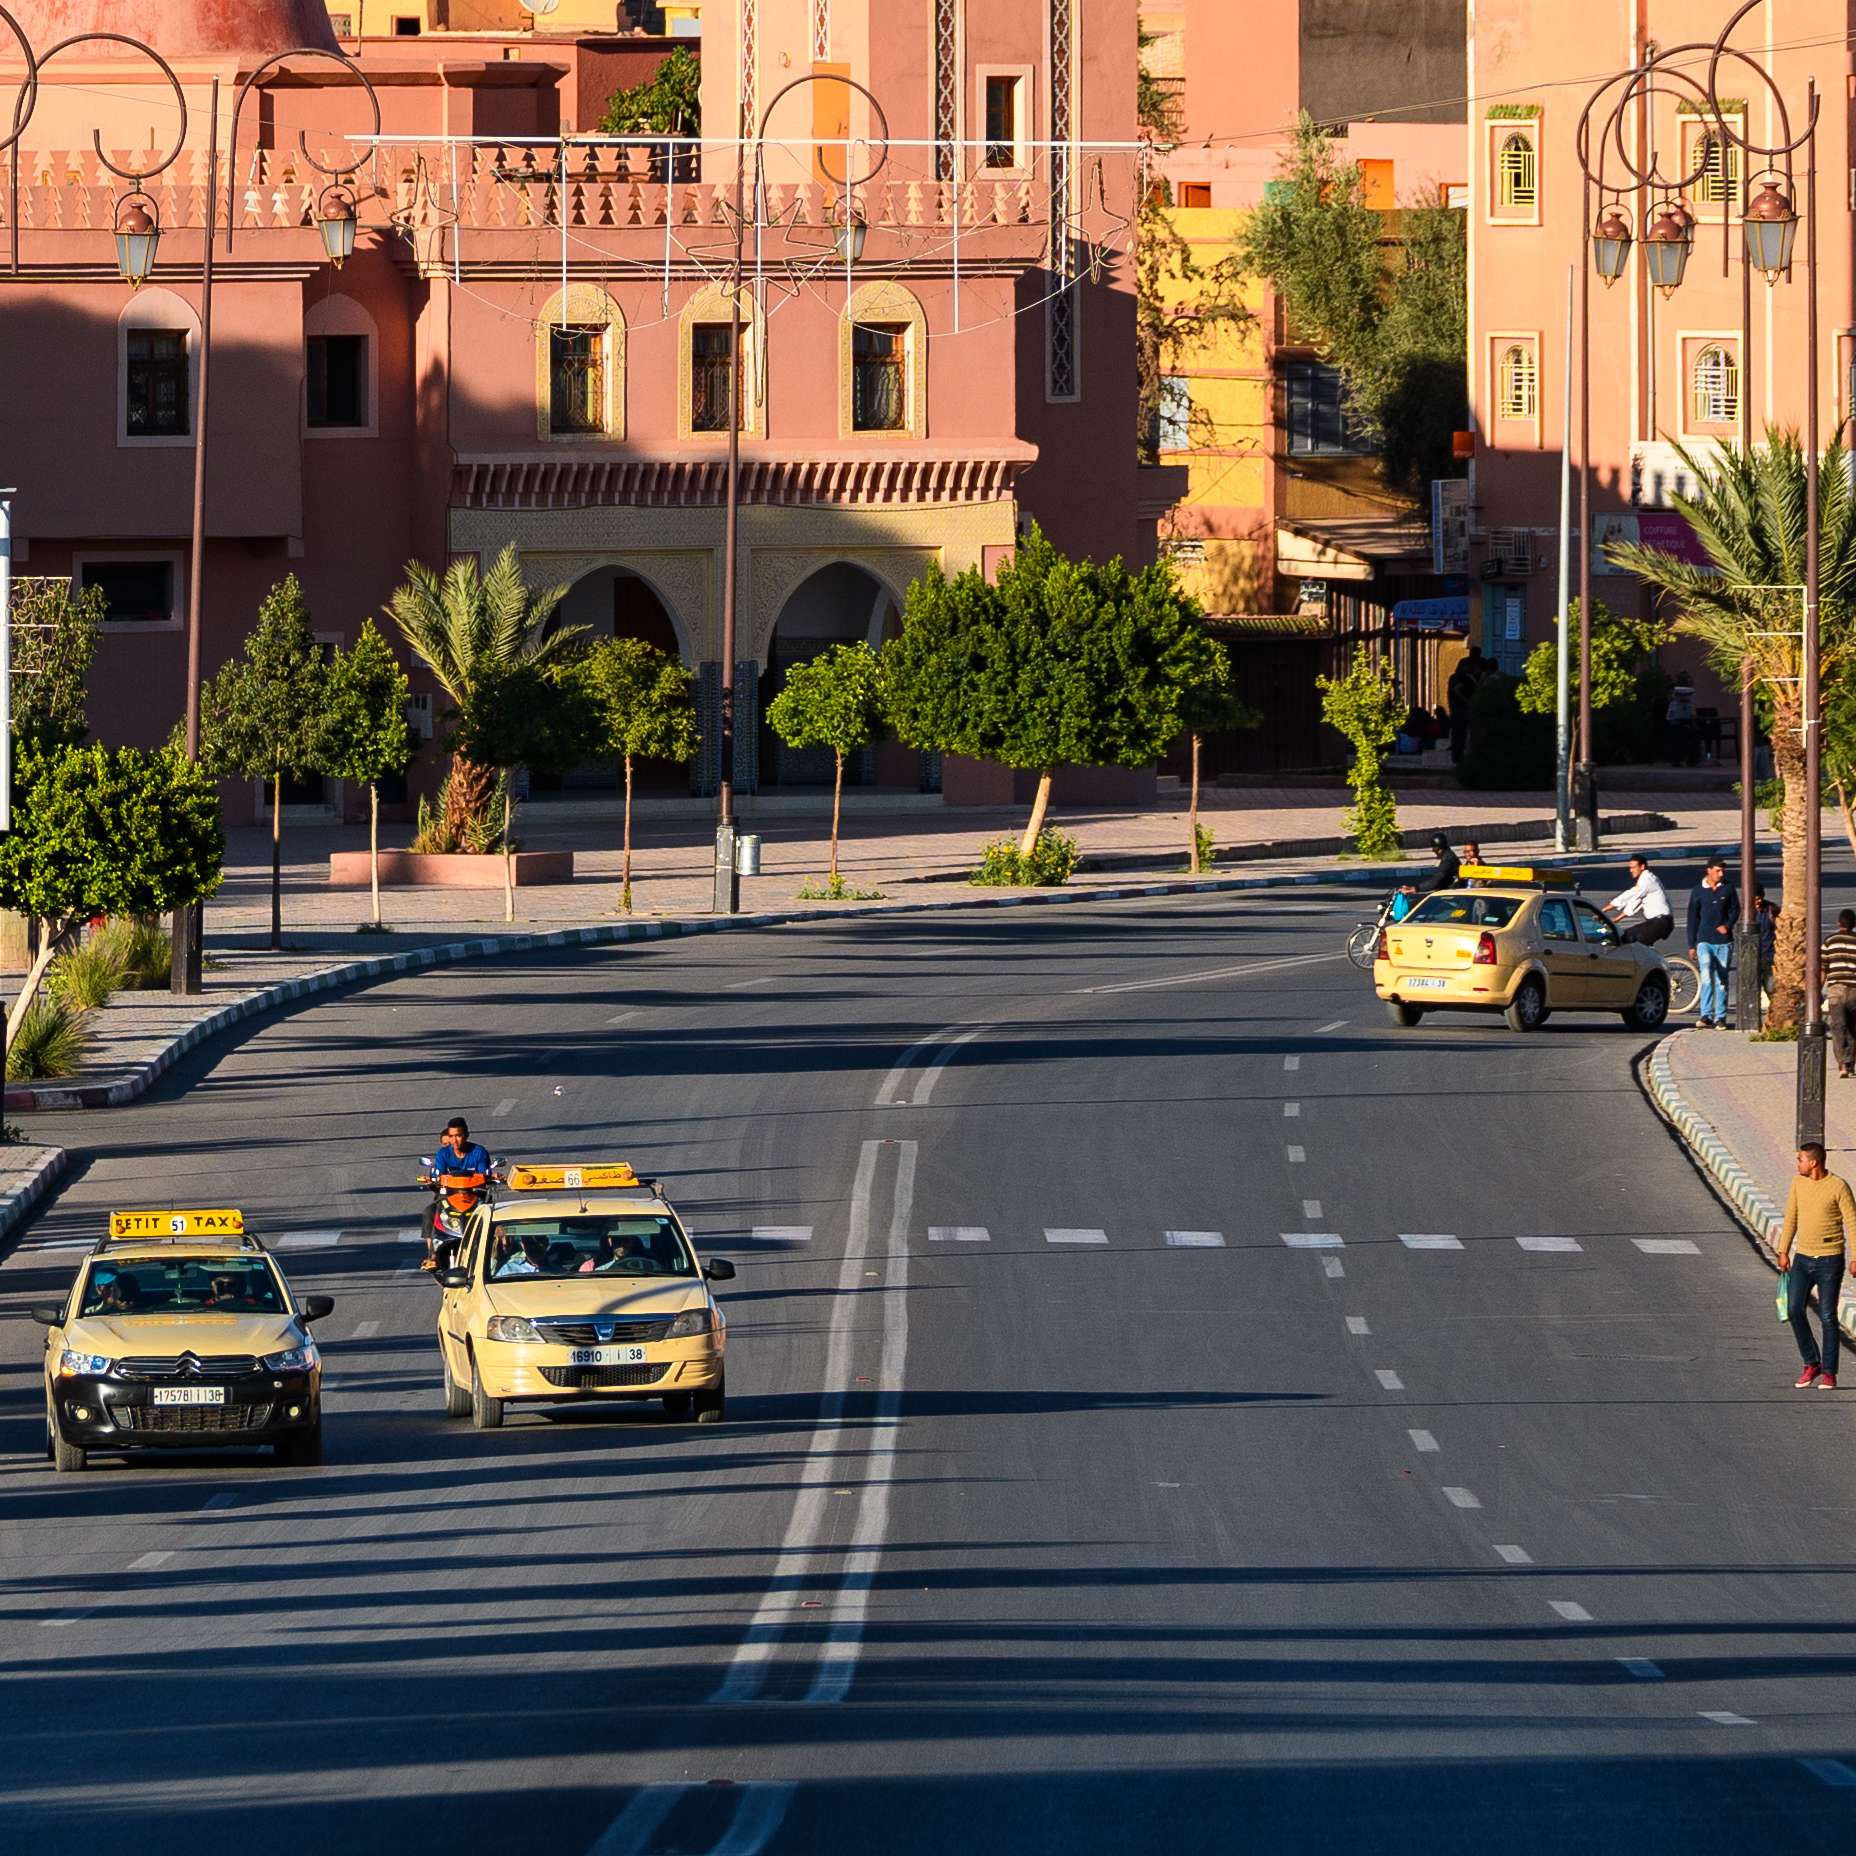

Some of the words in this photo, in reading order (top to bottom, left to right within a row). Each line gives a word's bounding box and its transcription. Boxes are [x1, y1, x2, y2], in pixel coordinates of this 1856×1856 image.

[115, 1217, 160, 1230] PETIT
[171, 1220, 184, 1231] 51
[571, 1349, 602, 1362] 16910
[629, 1348, 643, 1361] 38
[158, 1389, 189, 1402] 17578
